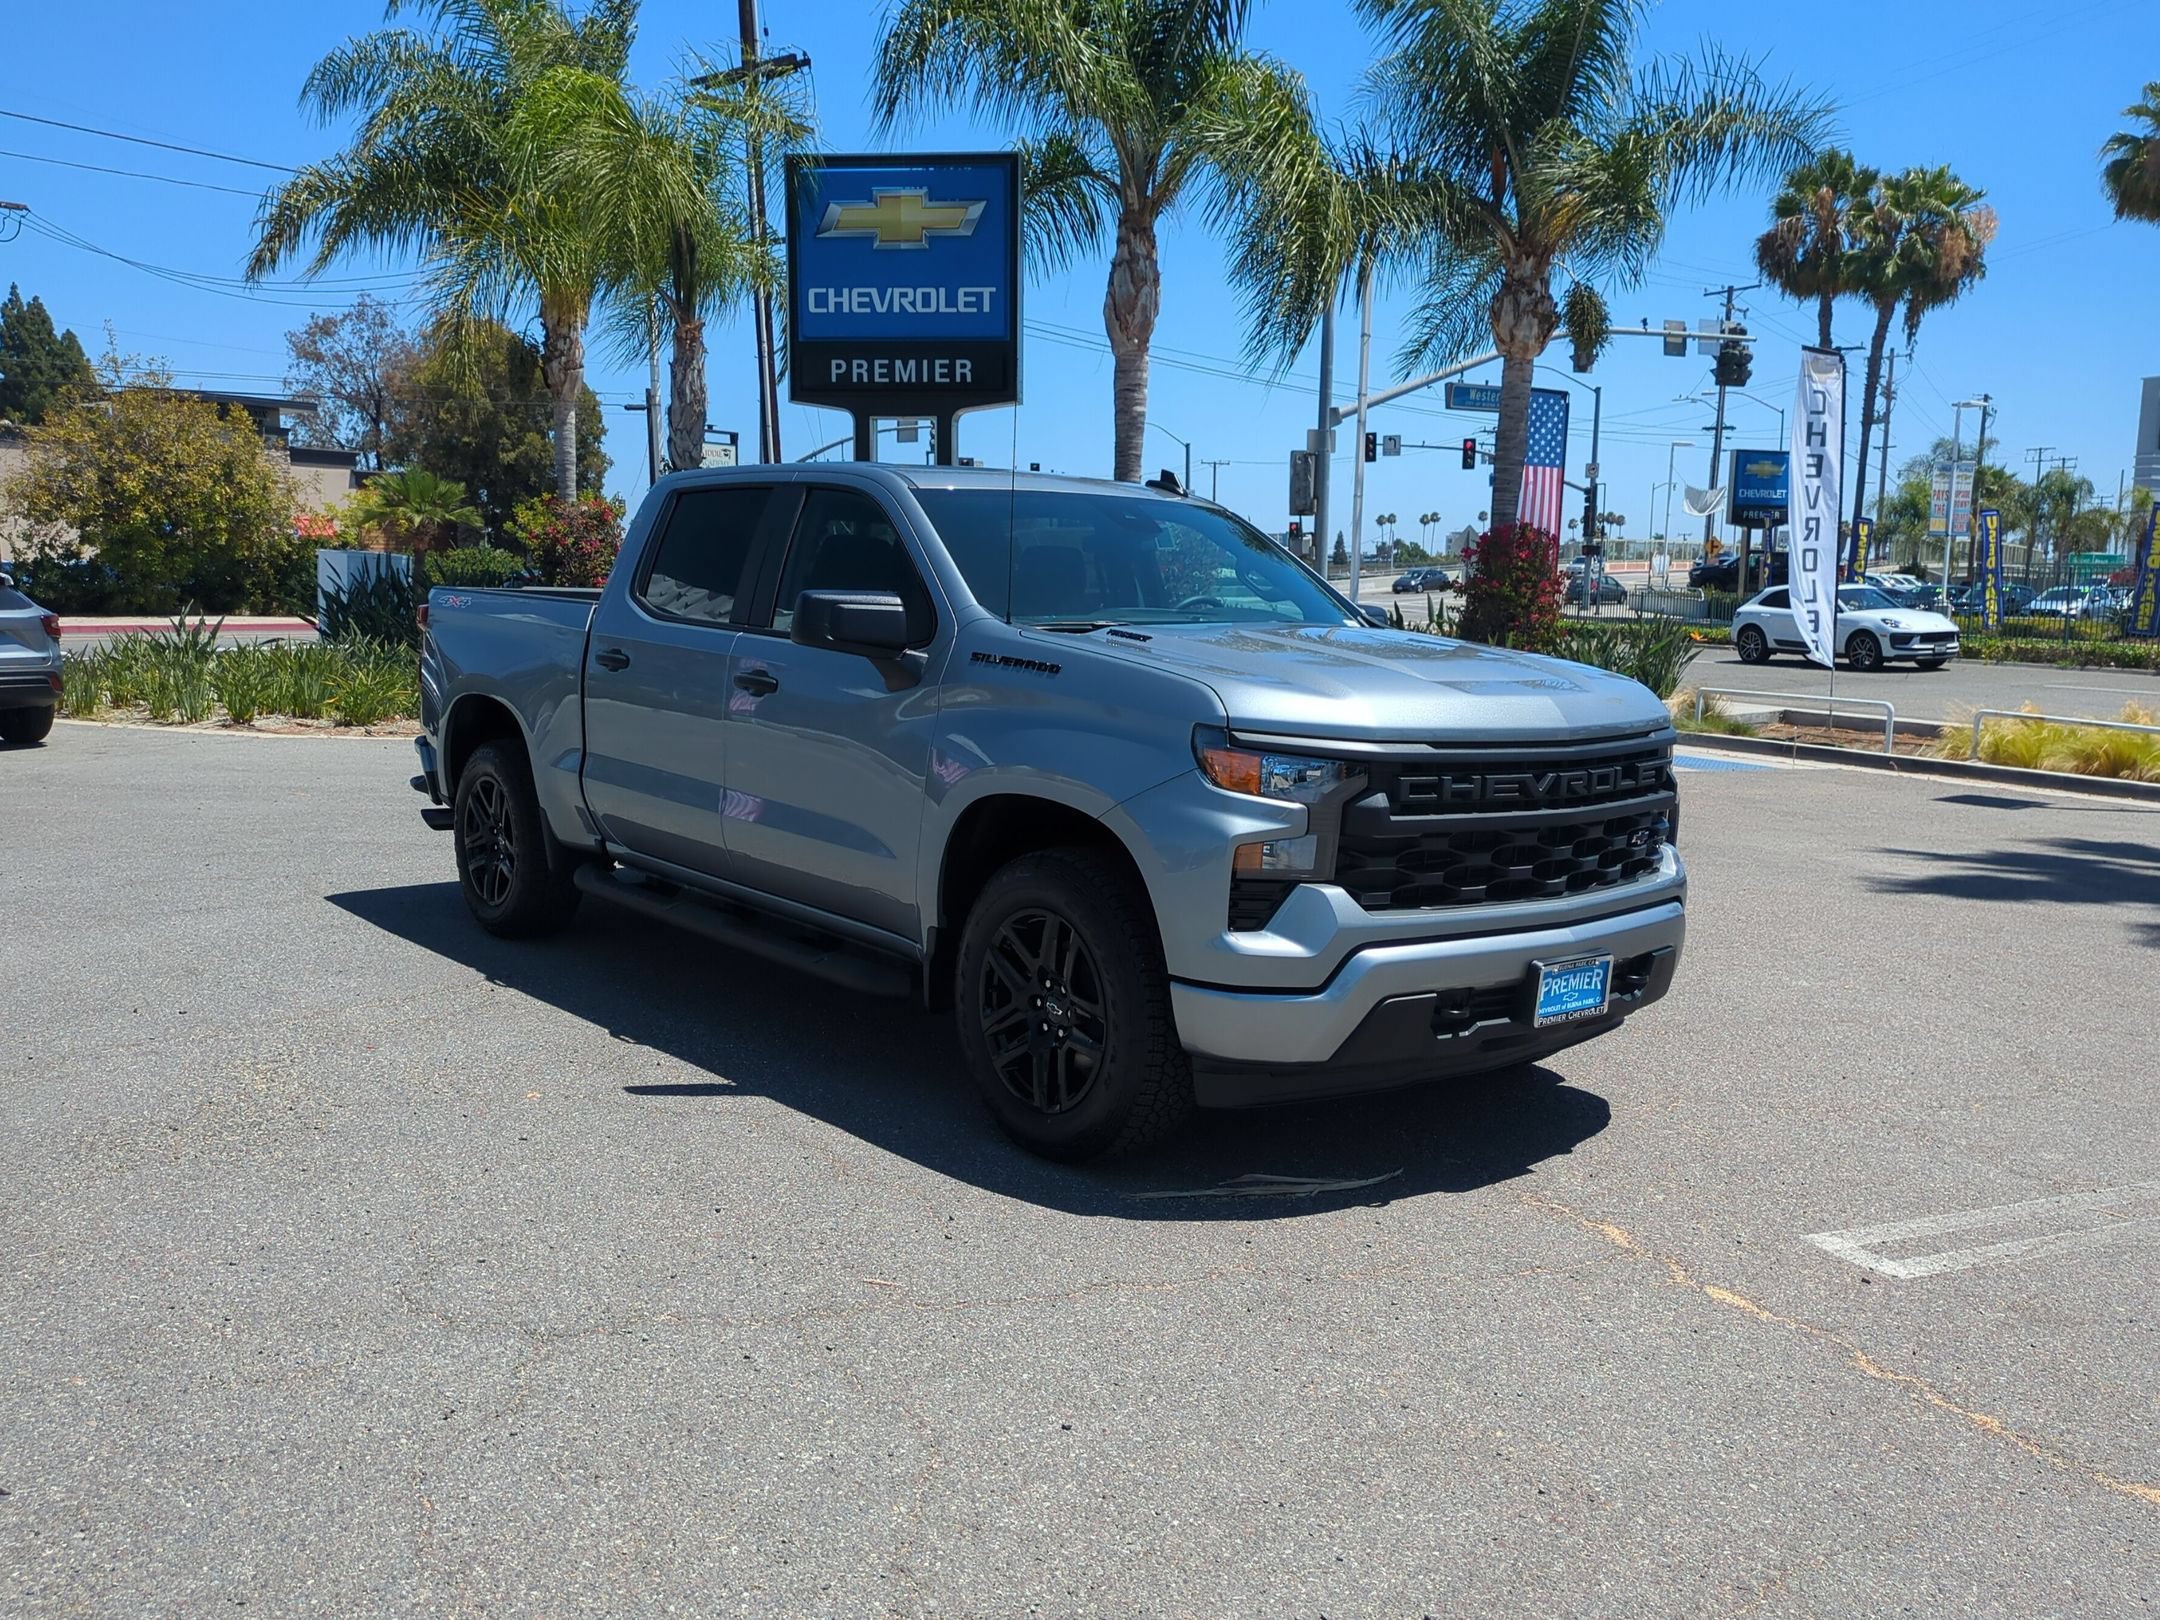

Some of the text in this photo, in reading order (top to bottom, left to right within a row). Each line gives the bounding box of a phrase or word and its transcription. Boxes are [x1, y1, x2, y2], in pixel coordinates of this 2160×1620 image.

[808, 287, 996, 313] CHEVROLET
[831, 359, 972, 383] PREMIER
[1470, 388, 1500, 401] Wester
[1739, 488, 1787, 499] CHEVROLET
[1743, 510, 1780, 519] PREMR
[970, 651, 1062, 675] SILVERADO
[1540, 969, 1603, 1001] PREMIER
[1538, 1006, 1605, 1026] PREMIER CHEVROLET
